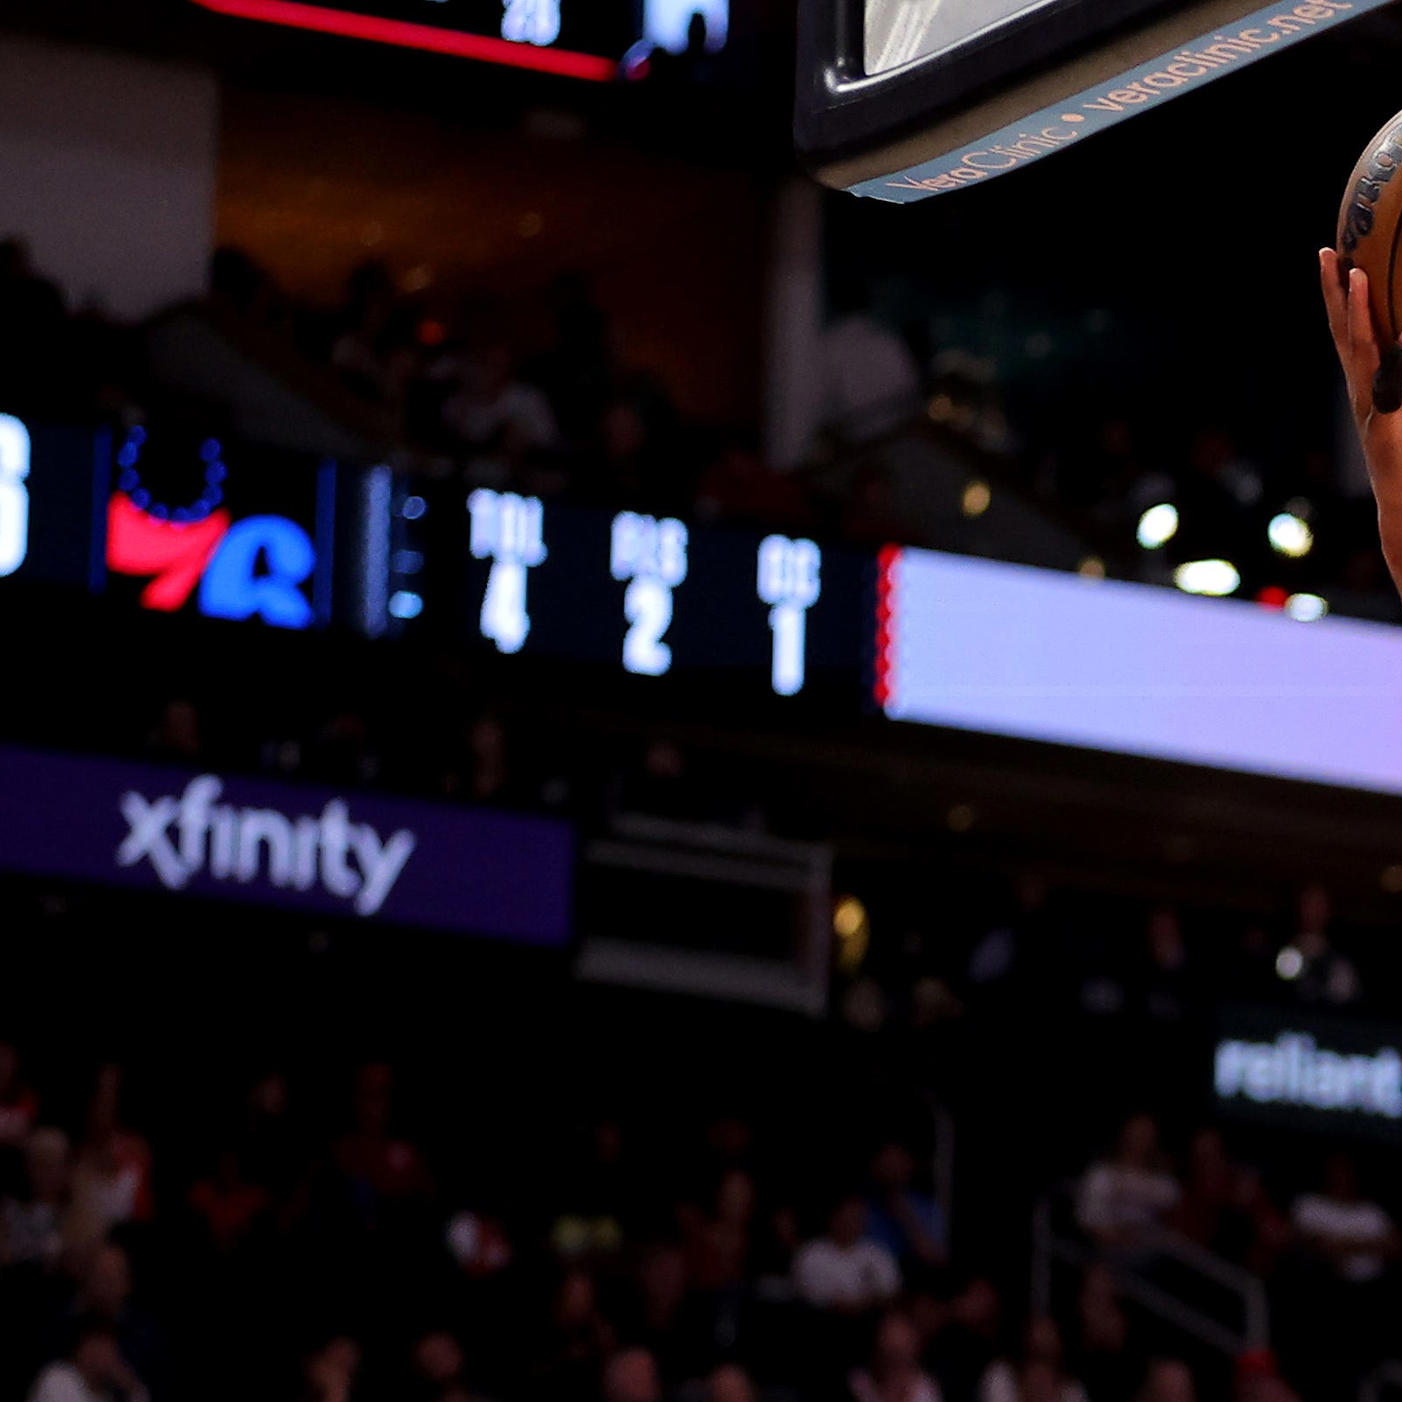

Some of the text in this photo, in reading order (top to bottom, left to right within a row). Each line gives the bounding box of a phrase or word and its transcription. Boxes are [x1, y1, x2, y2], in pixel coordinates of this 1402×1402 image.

[479, 556, 805, 696] 4 2 1
[117, 774, 416, 916] xfinity
